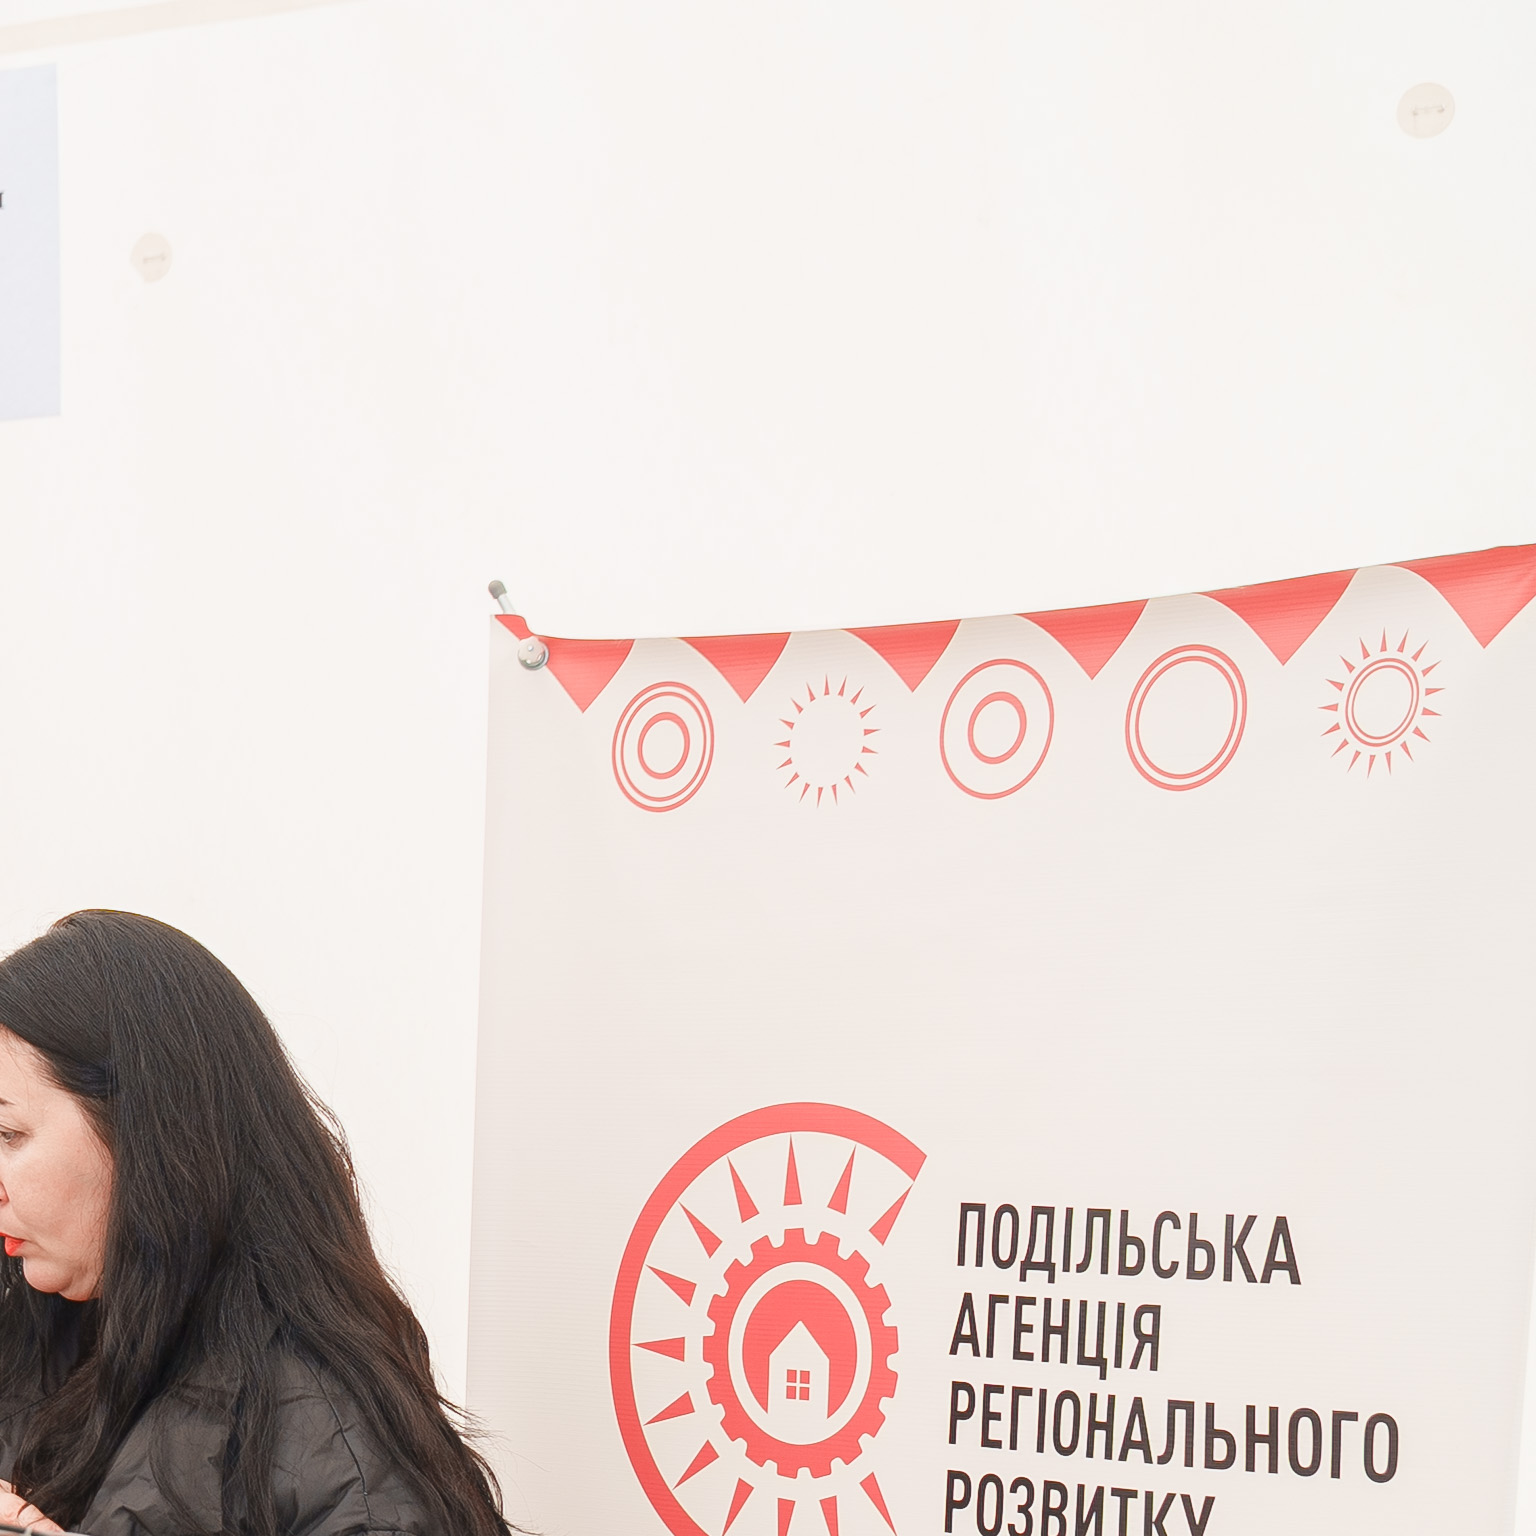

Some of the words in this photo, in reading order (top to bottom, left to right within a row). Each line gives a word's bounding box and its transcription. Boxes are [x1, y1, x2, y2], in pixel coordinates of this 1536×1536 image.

[957, 1202, 1302, 1286] ПОДІЛЬСЬКА
[948, 1292, 1162, 1380] АГЕНЦІЯ
[948, 1380, 1400, 1484] РЕГІОНАЛЬНОГО
